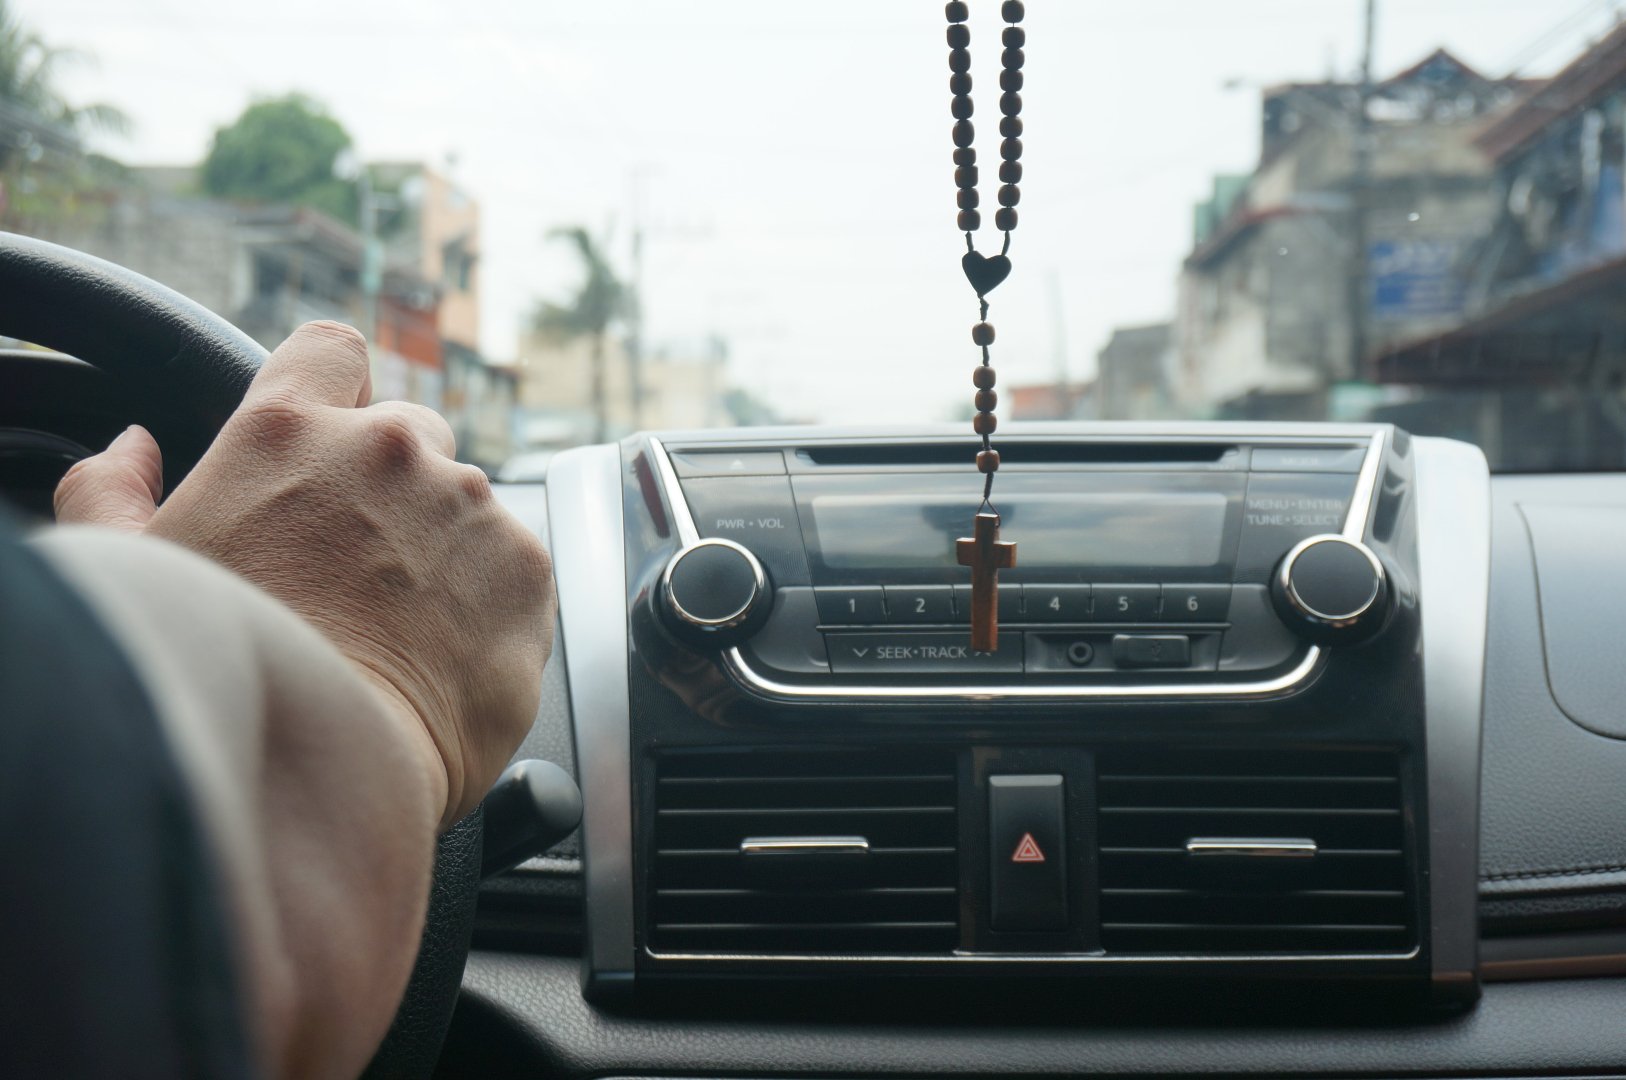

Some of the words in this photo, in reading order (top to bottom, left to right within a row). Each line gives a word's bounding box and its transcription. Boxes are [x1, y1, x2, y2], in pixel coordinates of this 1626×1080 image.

[716, 518, 746, 529] PWR
[757, 518, 785, 529] VOL
[849, 598, 856, 614] 1
[915, 598, 926, 614] 2
[1049, 596, 1060, 612] 4
[1118, 596, 1129, 612] 5
[1187, 596, 1199, 612] 6
